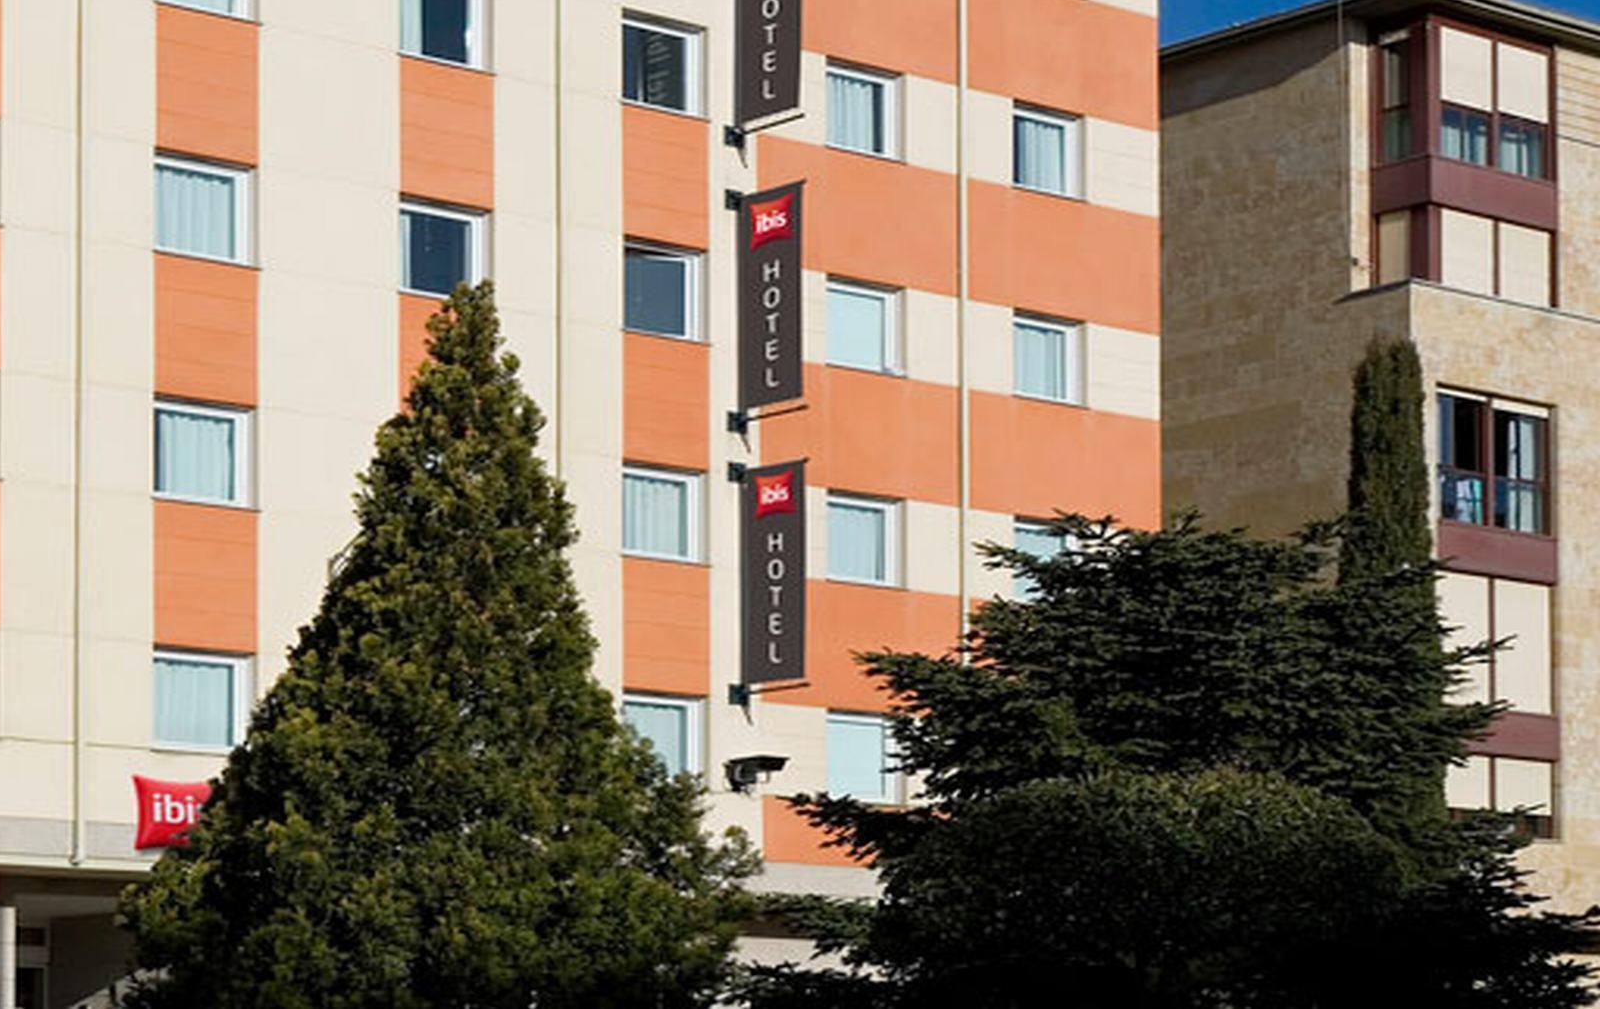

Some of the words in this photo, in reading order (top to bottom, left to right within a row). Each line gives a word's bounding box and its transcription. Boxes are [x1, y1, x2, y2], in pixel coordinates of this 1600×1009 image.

[756, 211, 787, 234] ibis
[763, 259, 780, 387] HOTEL
[760, 483, 789, 505] ibis
[767, 532, 785, 664] HOTEL
[153, 793, 202, 824] ibi
